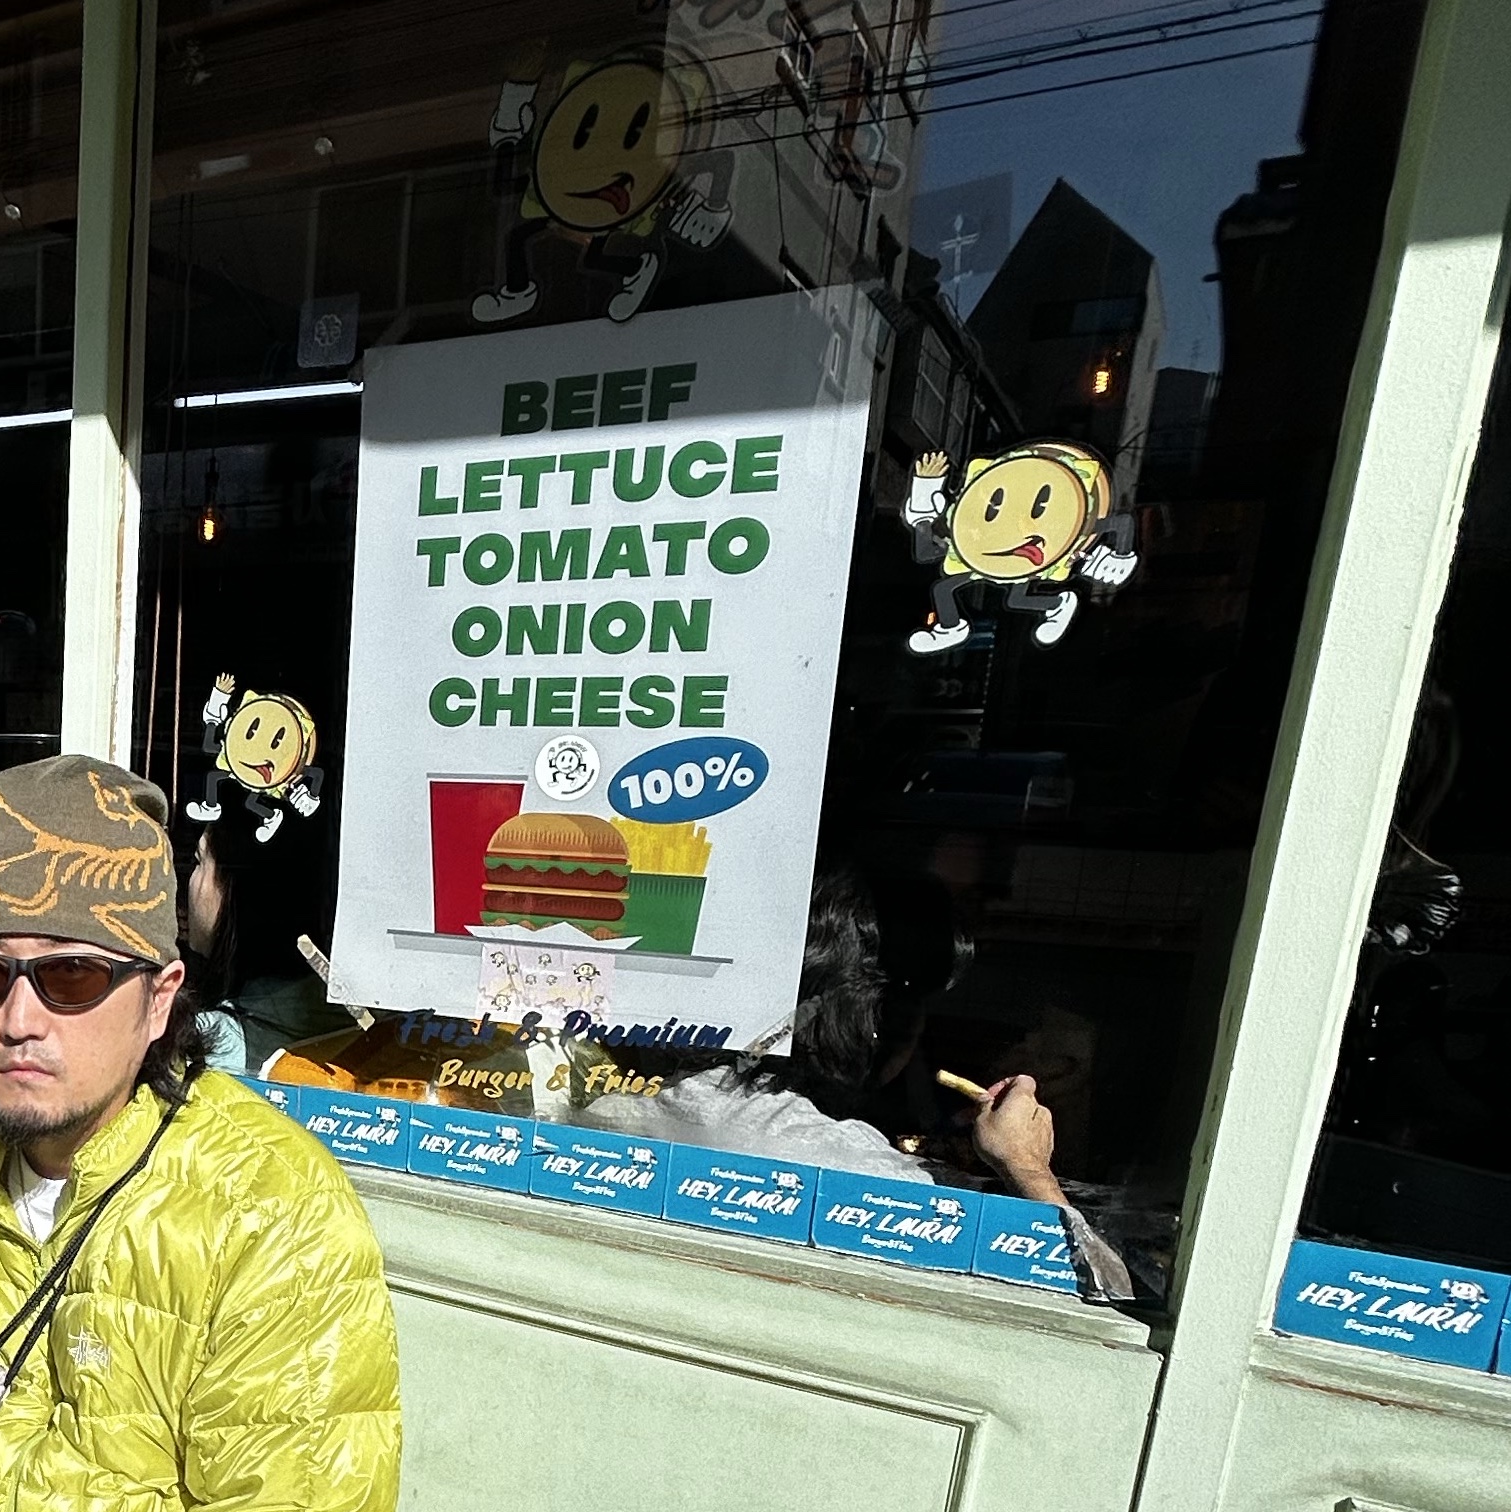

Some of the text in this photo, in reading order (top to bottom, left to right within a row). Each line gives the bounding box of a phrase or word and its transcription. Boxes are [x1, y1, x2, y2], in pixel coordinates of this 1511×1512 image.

[499, 361, 699, 437] BEEF
[418, 434, 783, 518] LETTUCE
[416, 517, 771, 589] TOMATO
[451, 599, 712, 660] ONION
[428, 673, 729, 729] CHEESE
[620, 752, 755, 810] 100%
[399, 1008, 734, 1050] Fresh & Premium
[439, 1058, 664, 1099] Burger & Fries
[1363, 1295, 1484, 1336] LAURA!
